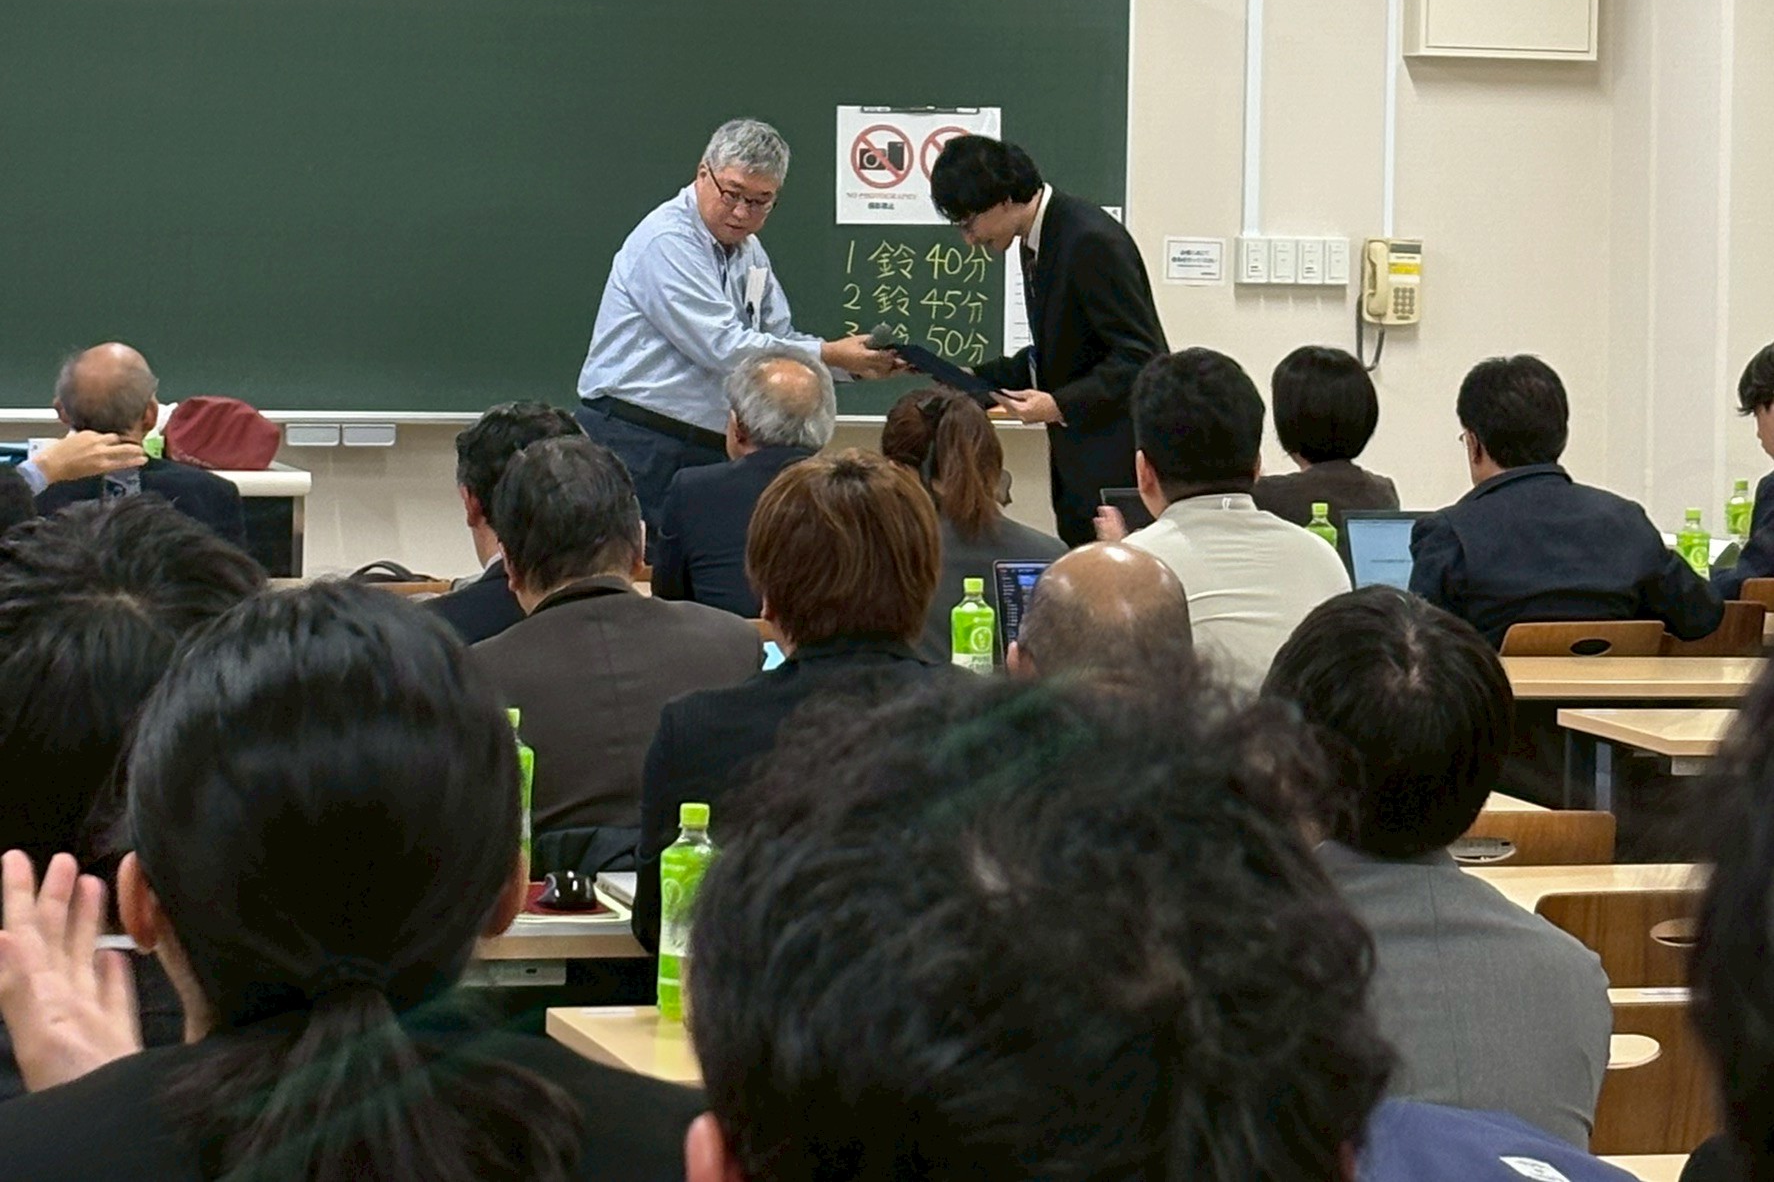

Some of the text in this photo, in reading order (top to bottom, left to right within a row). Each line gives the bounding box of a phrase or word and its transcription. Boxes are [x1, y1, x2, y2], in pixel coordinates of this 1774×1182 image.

[925, 243, 993, 283] 40分
[843, 283, 861, 310] 2
[920, 288, 989, 324] 45分
